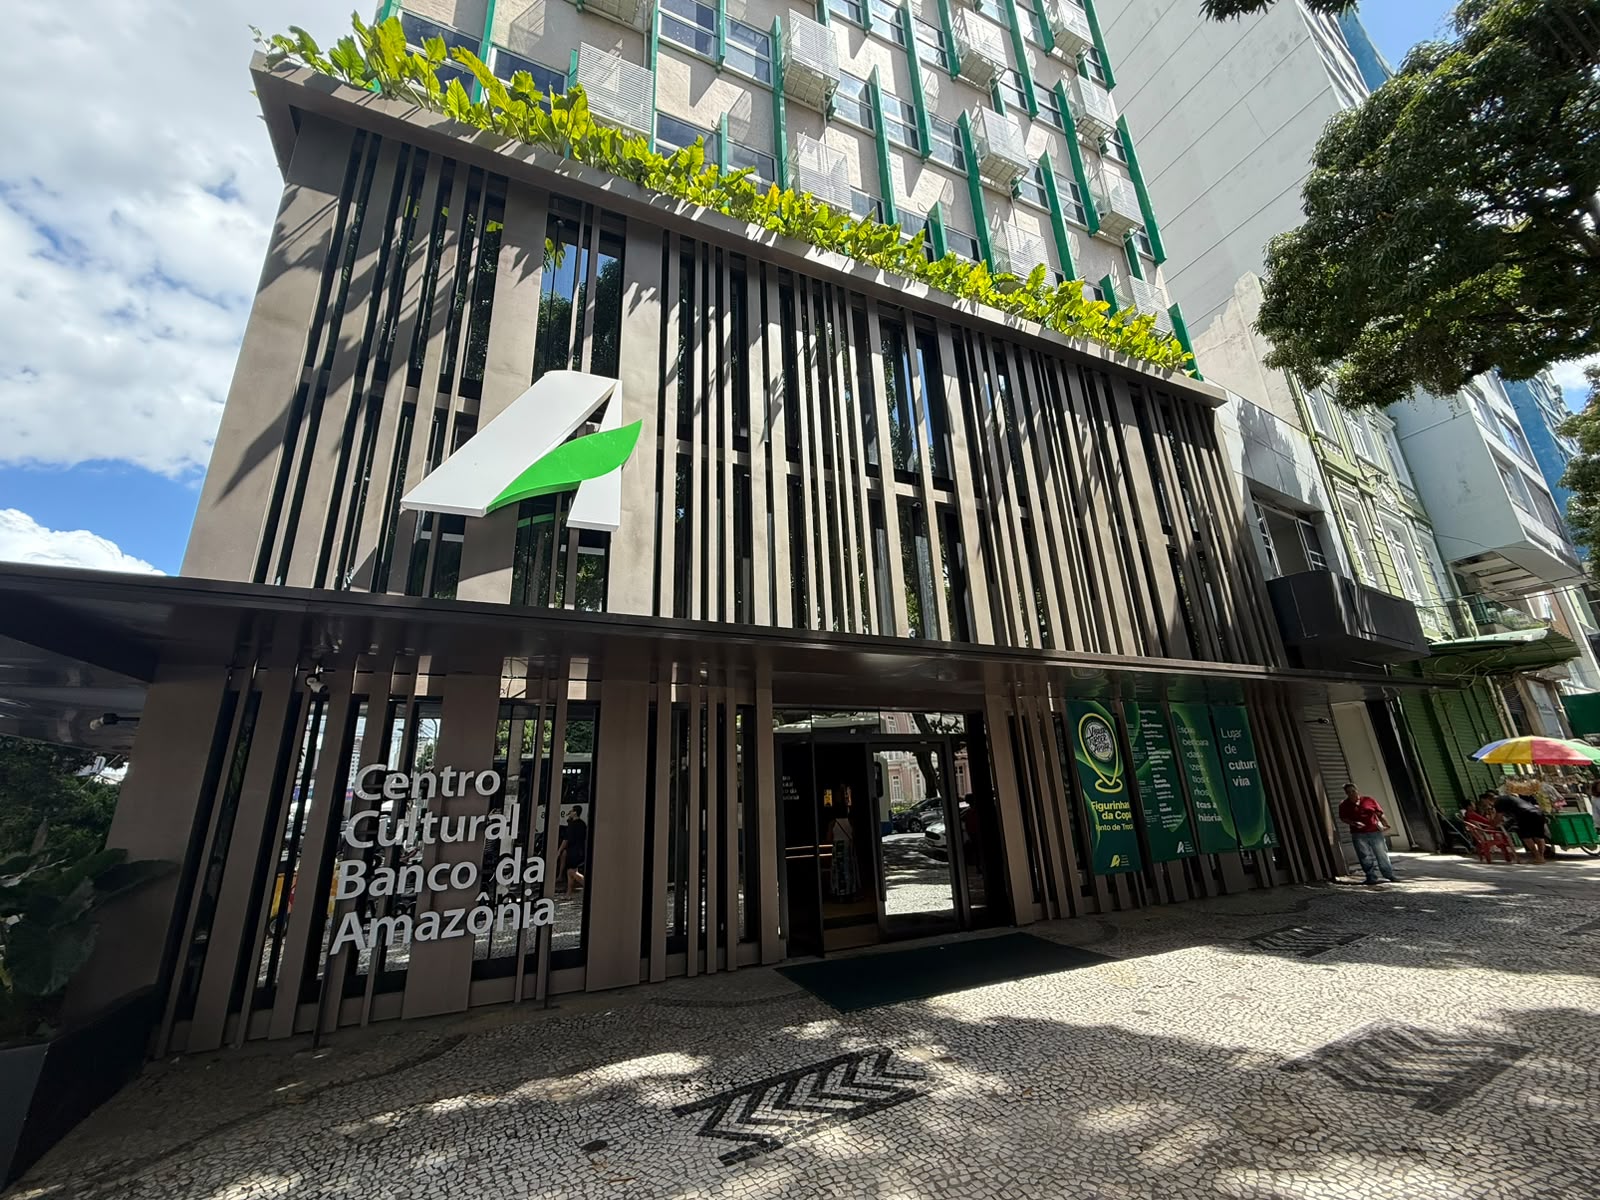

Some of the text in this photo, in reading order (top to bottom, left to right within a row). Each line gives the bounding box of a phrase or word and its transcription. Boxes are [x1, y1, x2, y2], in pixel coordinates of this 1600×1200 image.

[1224, 744, 1238, 754] de
[353, 763, 501, 801] Centro
[345, 802, 521, 849] Cultural
[1101, 811, 1114, 820] da
[1112, 823, 1121, 831] de
[335, 846, 546, 900] Banco da
[329, 889, 555, 956] Amazônia
